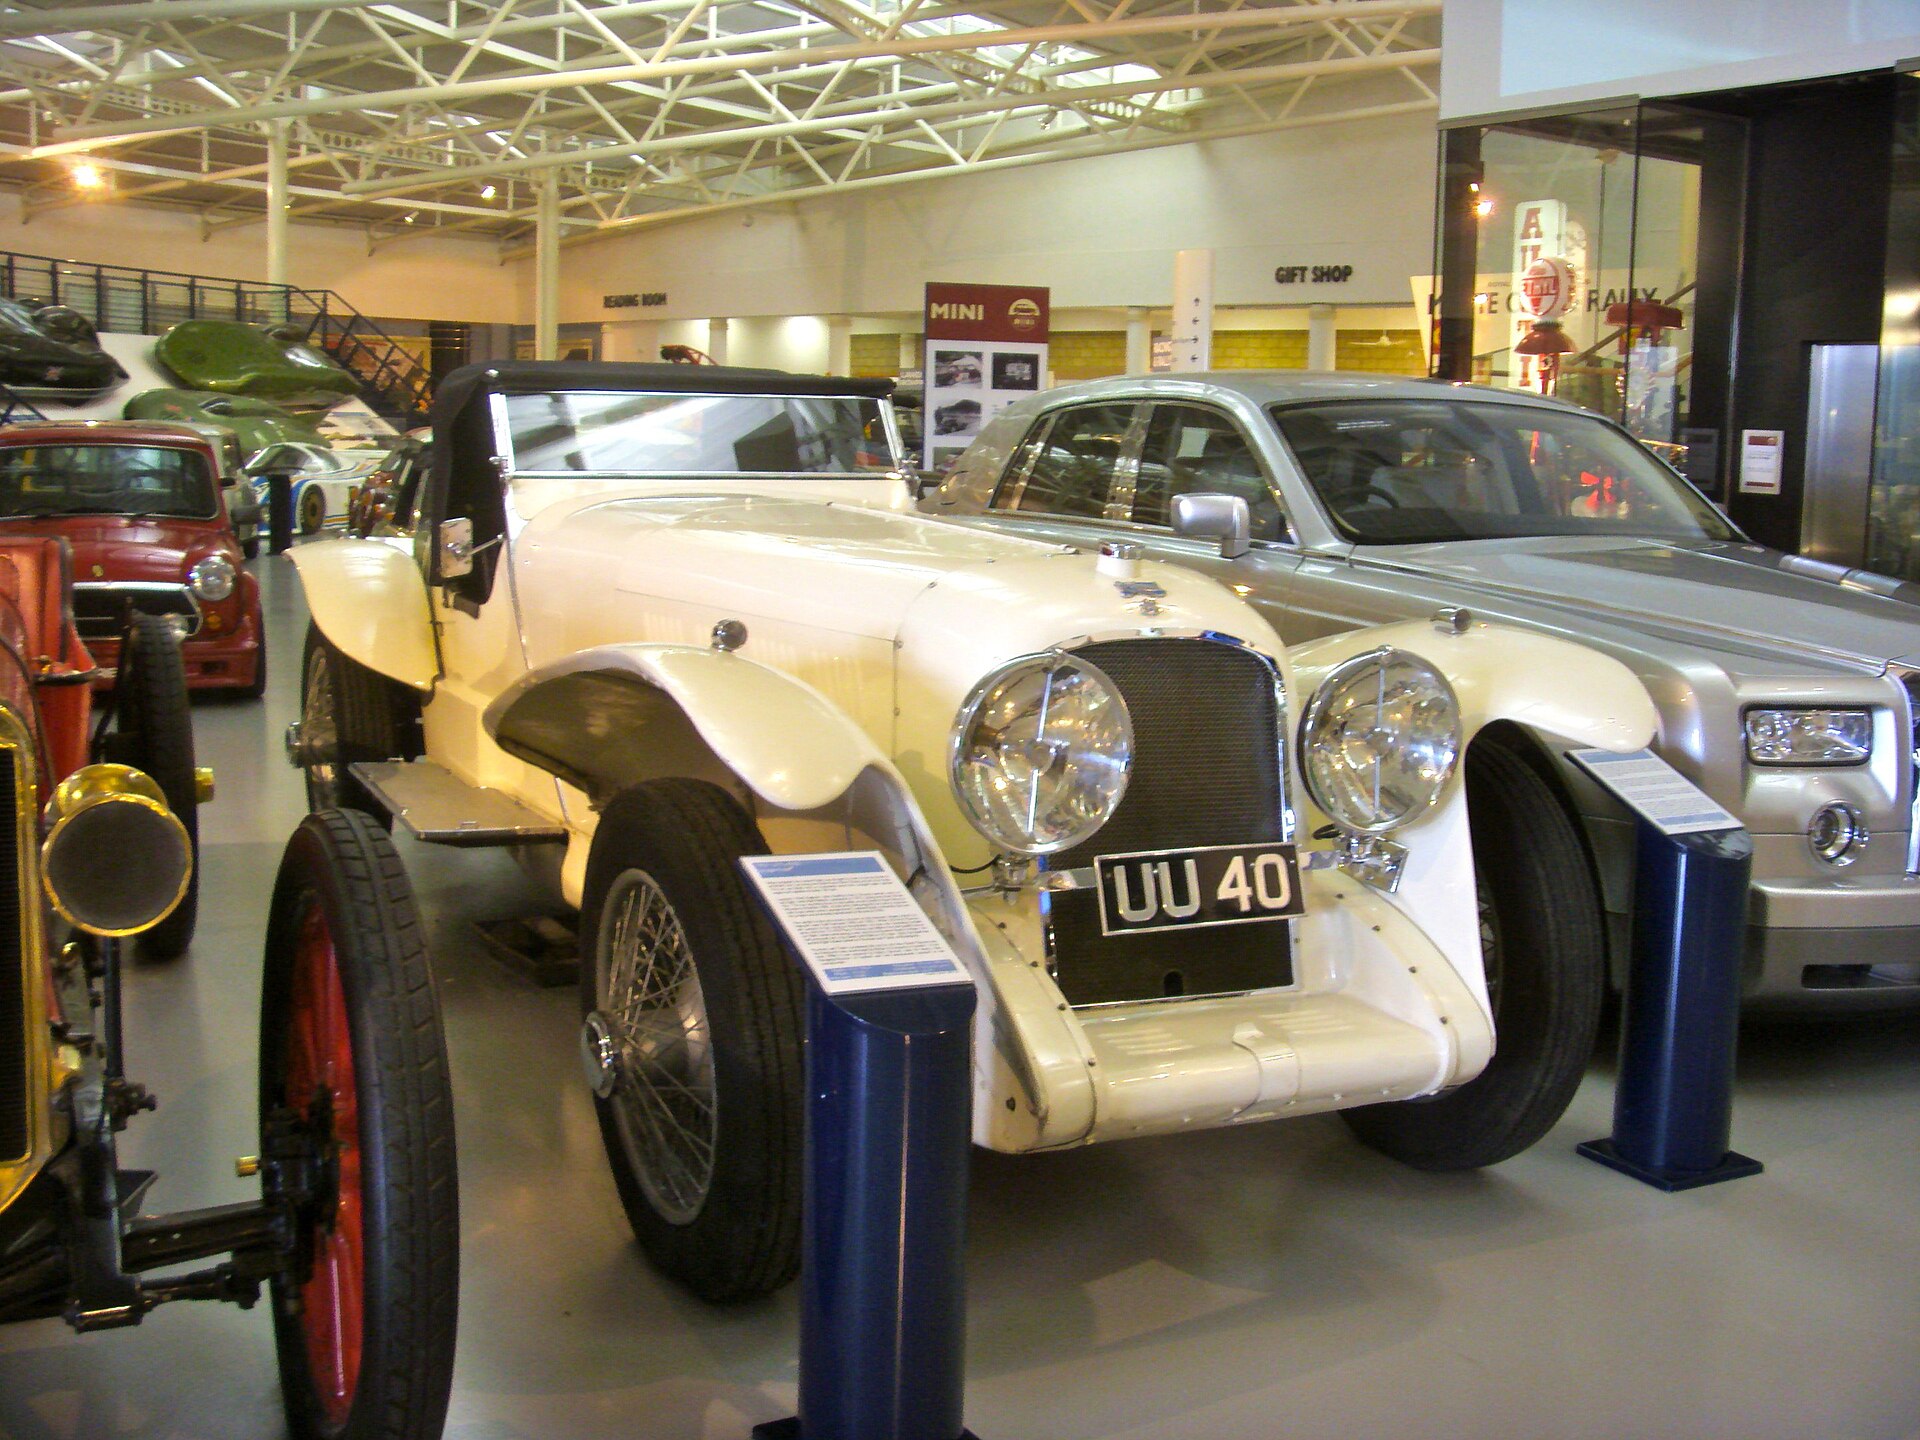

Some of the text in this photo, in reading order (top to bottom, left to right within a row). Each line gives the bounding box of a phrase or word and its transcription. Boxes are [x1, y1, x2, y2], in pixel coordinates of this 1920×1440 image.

[1275, 265, 1353, 284] GIFT SHOP
[642, 292, 667, 306] ROOM
[930, 302, 985, 321] MINI
[1113, 853, 1292, 922] UU 40
